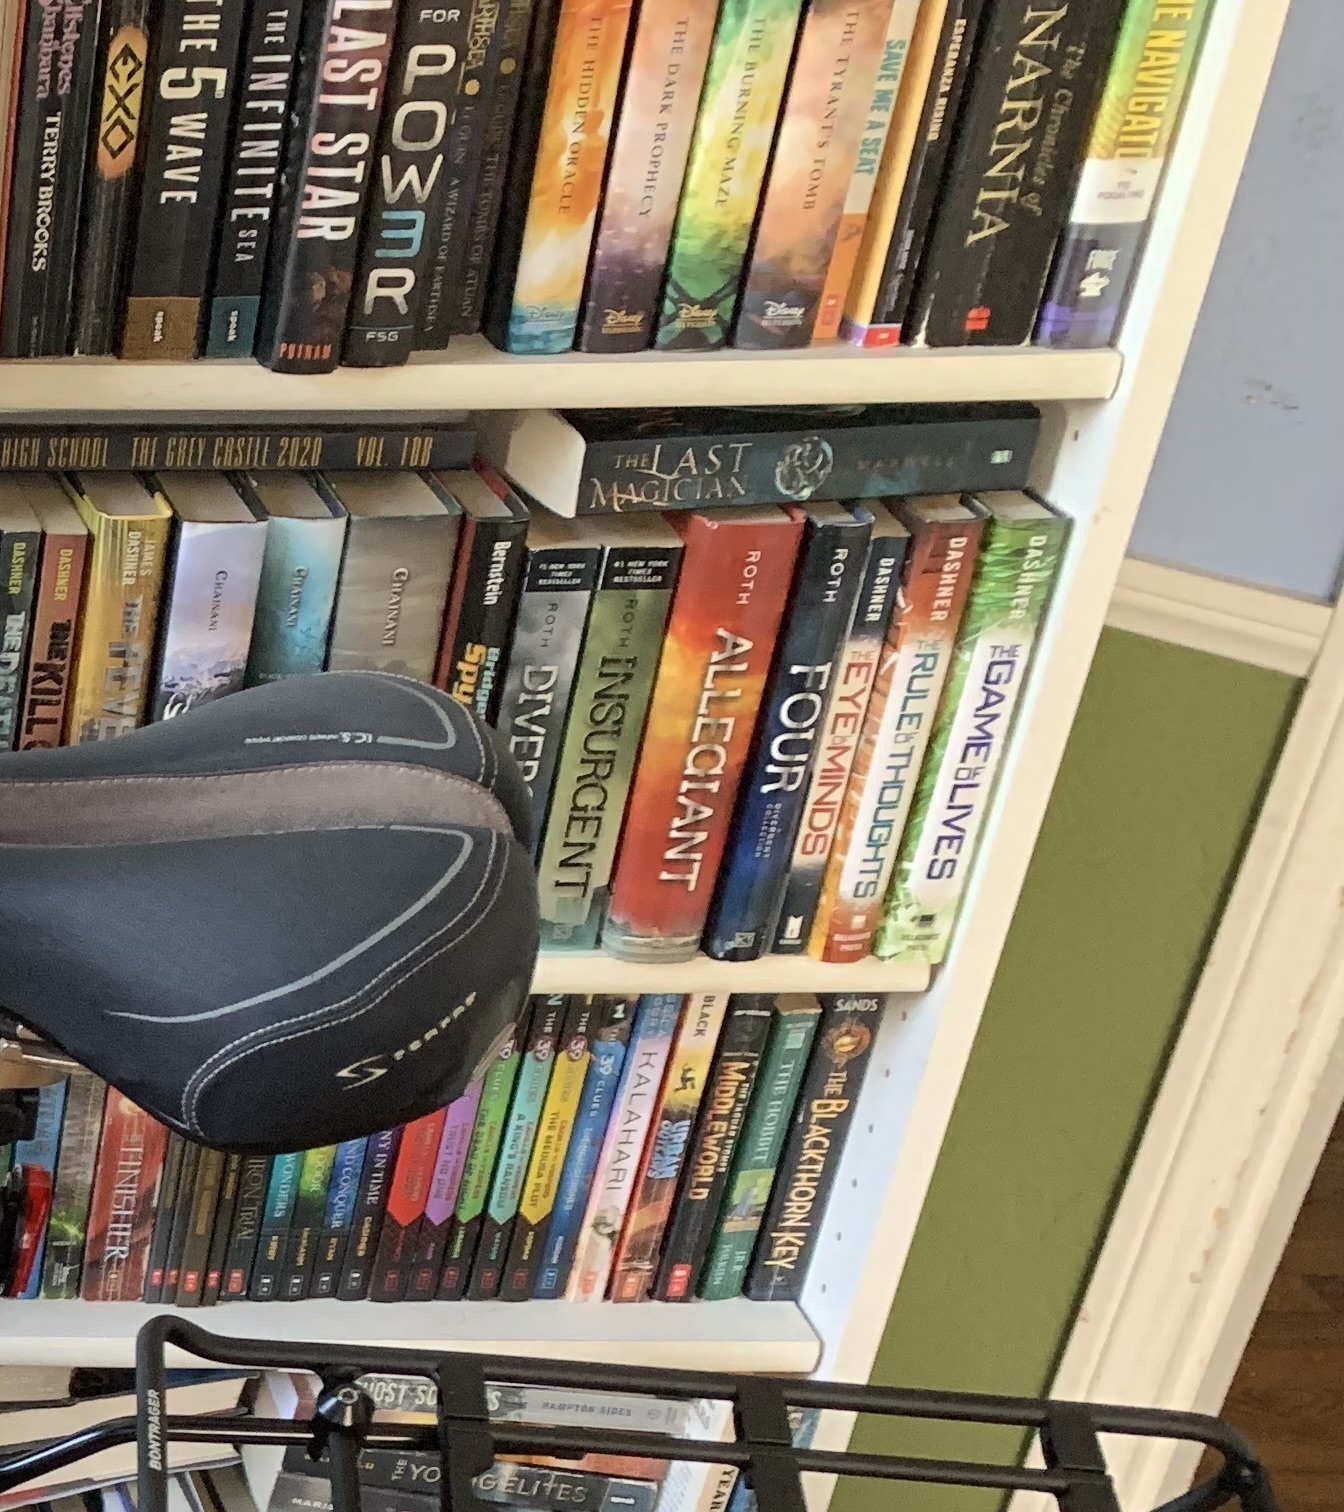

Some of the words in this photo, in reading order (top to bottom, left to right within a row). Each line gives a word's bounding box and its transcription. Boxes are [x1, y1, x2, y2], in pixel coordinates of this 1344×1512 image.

[264, 9, 289, 44] THE
[419, 9, 460, 23] FOR
[586, 17, 603, 55] THE
[672, 18, 690, 55] THE
[747, 18, 767, 55] THE
[838, 11, 859, 46] THE
[873, 38, 906, 82] SAVE
[937, 19, 967, 94] ESPERANZA
[570, 65, 596, 134] HIDDEN
[657, 63, 682, 115] DARK
[725, 62, 760, 149] BURNING
[815, 53, 851, 149] TYRANT'S
[870, 88, 895, 113] ME
[40, 111, 61, 181] TERRY
[231, 54, 292, 223] INFINITE
[864, 119, 883, 130] A
[964, 3, 1068, 248] NARNIA
[1031, 88, 1073, 186] Chronicles
[160, 112, 208, 205] WAVE
[558, 141, 582, 215] ORACLE
[639, 122, 671, 218] PROPHECY
[855, 136, 882, 177] SEAT
[297, 133, 370, 241] STAR
[717, 157, 738, 208] MAZE
[802, 156, 827, 211] TOMB
[31, 184, 54, 272] BROOKS
[440, 188, 459, 242] WIZARD
[234, 229, 258, 263] SEA
[603, 309, 644, 325] Disney
[678, 303, 718, 319] Disney
[763, 300, 806, 317] Disney
[366, 331, 399, 342] FSG
[1, 438, 40, 467] HIGH
[47, 438, 109, 468] SCHOOL
[131, 437, 158, 468] THE
[165, 437, 208, 467] GREY
[213, 437, 271, 467] CASTLE
[277, 436, 323, 467] 2020
[357, 437, 389, 467] VOL.
[401, 436, 433, 467] 108
[614, 453, 650, 470] THE
[636, 443, 754, 480] LAST
[590, 475, 749, 512] MAGICIAN
[7, 541, 26, 595] DASHNER
[53, 548, 74, 602] DASHNER
[121, 530, 142, 586] DASHNER
[139, 538, 157, 578] JAMES
[483, 540, 512, 607] Bernstein
[647, 560, 669, 568] YORK
[735, 550, 761, 605] ROTH
[822, 548, 849, 603] ROTH
[930, 536, 969, 622] DASHNER
[1007, 534, 1048, 621] DASHNER
[208, 570, 228, 632] CHAINANI
[286, 565, 308, 628] CHAINANI
[381, 567, 410, 646] CHAINANI
[864, 556, 896, 623] DASHNER
[2, 611, 26, 660] THE
[42, 619, 73, 661] THE
[540, 602, 559, 648] ROTH
[619, 599, 638, 648] ROTH
[917, 639, 940, 651] THE
[452, 641, 487, 705] Spy
[850, 650, 876, 662] THE
[988, 643, 1023, 660] THE
[24, 663, 65, 735] KILL
[830, 661, 876, 736] EYE
[894, 652, 941, 732] RULE
[958, 658, 1018, 764] GAME
[760, 661, 834, 794] FOUR
[554, 655, 639, 898] INSURGENT
[658, 627, 754, 892] ALLEGIANT
[954, 765, 987, 781] OF
[799, 745, 854, 856] MINDS
[853, 746, 914, 899] THOUGHTS
[926, 783, 981, 881] LIVES
[543, 1010, 557, 1033] THE
[576, 1010, 590, 1033] THE
[693, 995, 716, 1038] BLACK
[834, 998, 878, 1013] SANDS
[534, 1036, 554, 1061] 39
[568, 1036, 587, 1061] 39
[598, 1054, 616, 1076] 39
[588, 1079, 608, 1118] CLUES
[773, 1059, 796, 1092] THE
[823, 1070, 848, 1097] THE
[546, 1110, 560, 1132] THE
[605, 1052, 659, 1191] KALAHARI
[689, 1061, 750, 1200] MIDDLEWORLD
[754, 1099, 786, 1165] HOBBIT
[243, 1158, 267, 1199] IRON
[374, 1156, 387, 1173] IN
[535, 1134, 554, 1179] MEDUSA
[777, 1098, 850, 1235] BLACKTHORN
[330, 1169, 354, 1229] CONQUER
[367, 1174, 385, 1205] TIME
[236, 1203, 258, 1241] TRIAL
[764, 1231, 807, 1270] KEY
[148, 1388, 160, 1472] BONTRAGER
[542, 1401, 595, 1413] HAMPTON
[599, 1404, 632, 1417] SIDES
[392, 1459, 408, 1481] THE
[504, 1471, 589, 1502] ELITES
